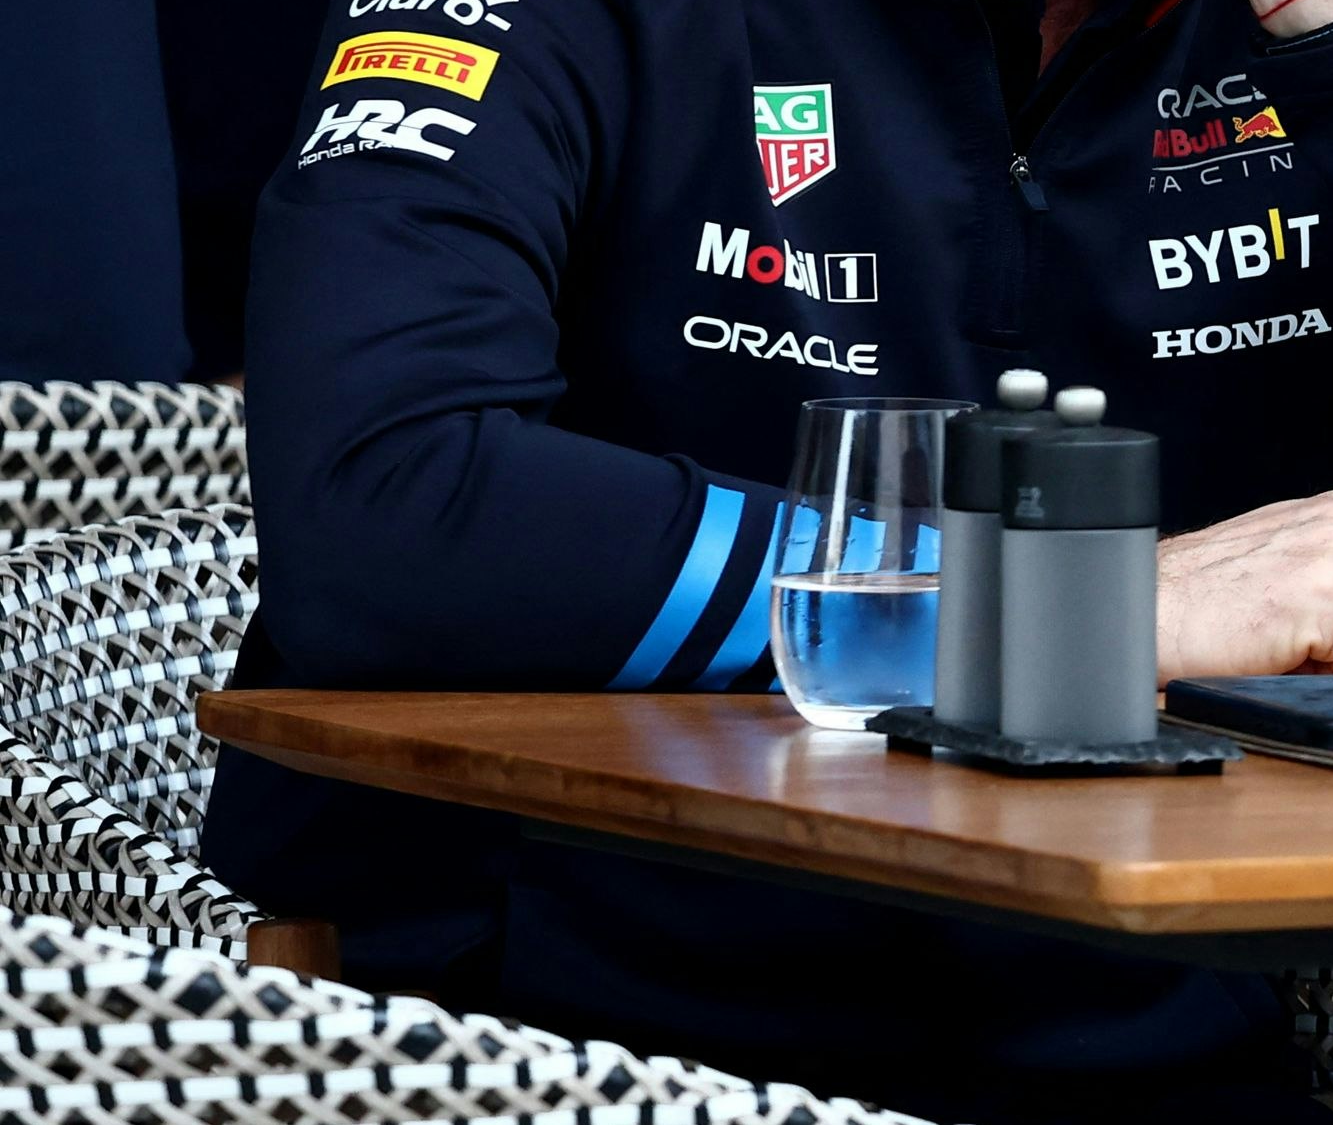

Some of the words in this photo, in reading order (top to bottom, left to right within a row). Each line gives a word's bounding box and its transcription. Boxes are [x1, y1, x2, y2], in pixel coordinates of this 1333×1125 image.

[334, 41, 477, 84] PIRELLI
[299, 99, 478, 162] HRC
[754, 94, 820, 132] AG
[297, 140, 356, 170] Honda
[696, 221, 821, 301] Mobil
[1148, 208, 1320, 290] BYBIT
[683, 315, 879, 376] ORACLE
[1152, 308, 1333, 359] HONDA
